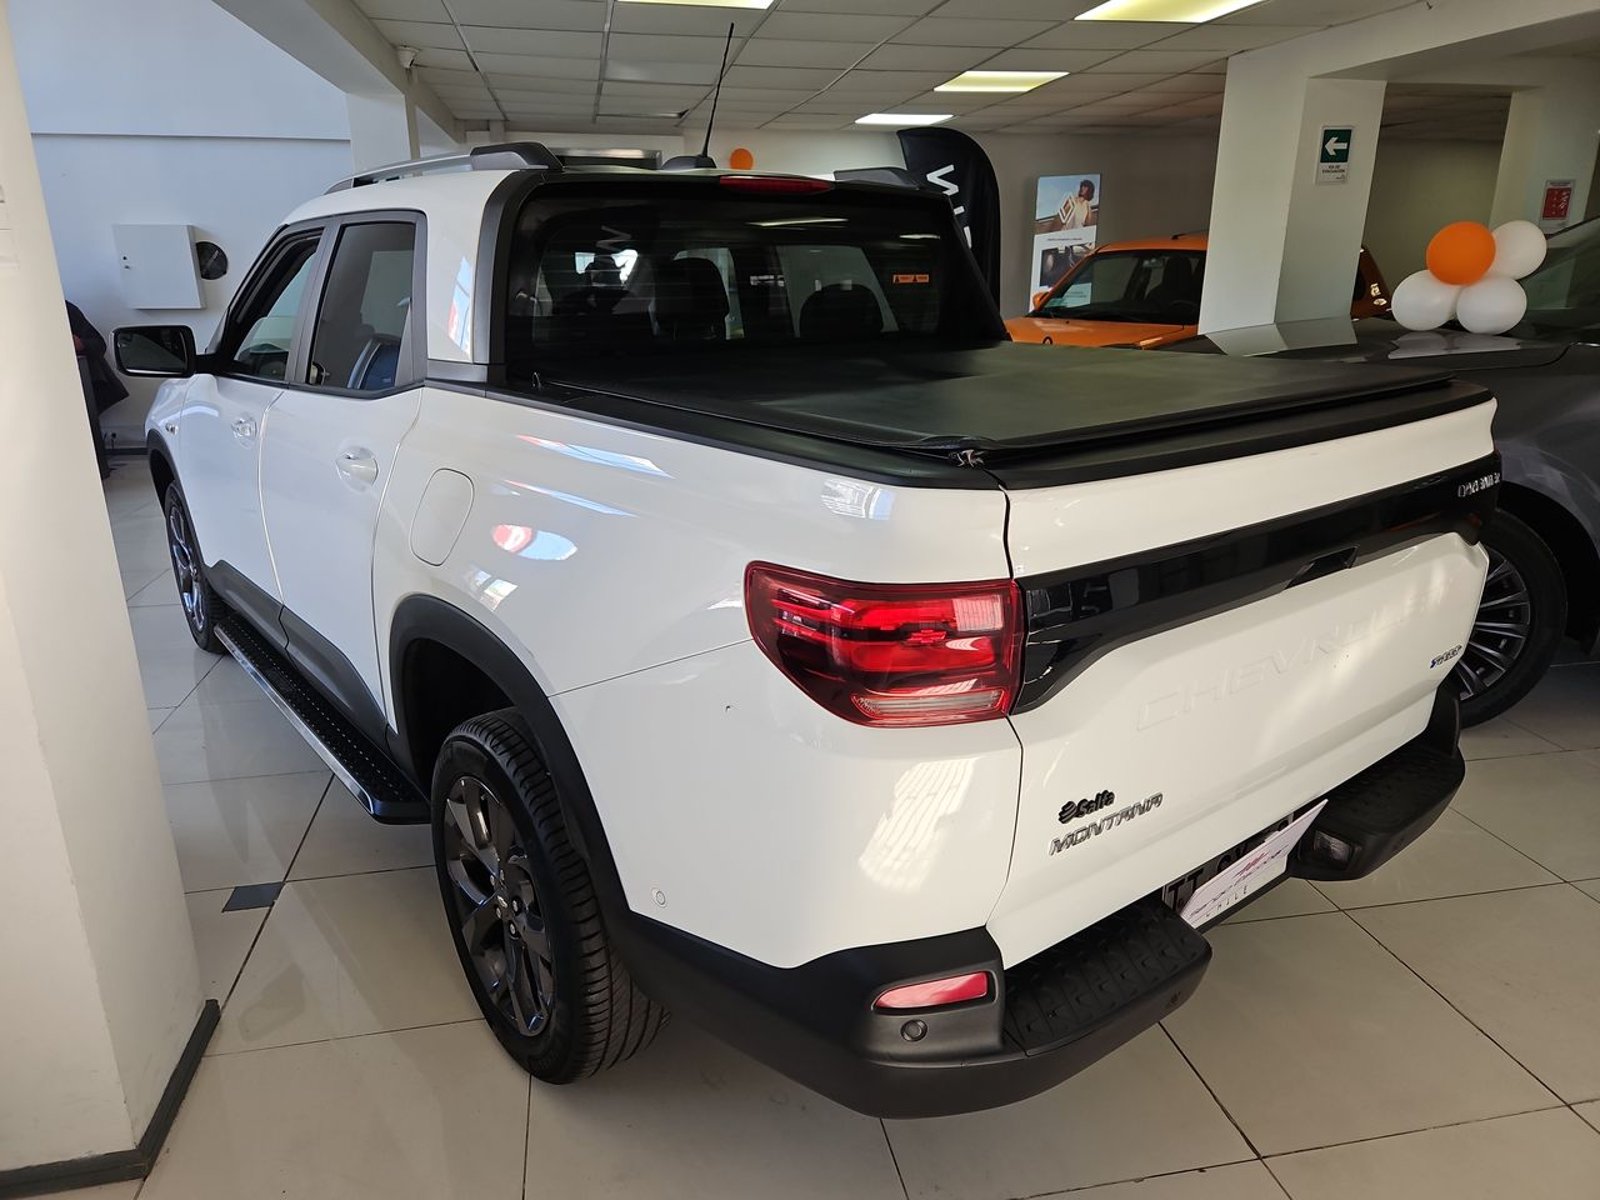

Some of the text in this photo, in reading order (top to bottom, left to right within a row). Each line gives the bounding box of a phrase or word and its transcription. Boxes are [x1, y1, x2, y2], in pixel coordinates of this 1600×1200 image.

[1137, 590, 1441, 731] CHEVROL
[1049, 792, 1163, 856] MONTANA
[1077, 790, 1116, 818] Salfa
